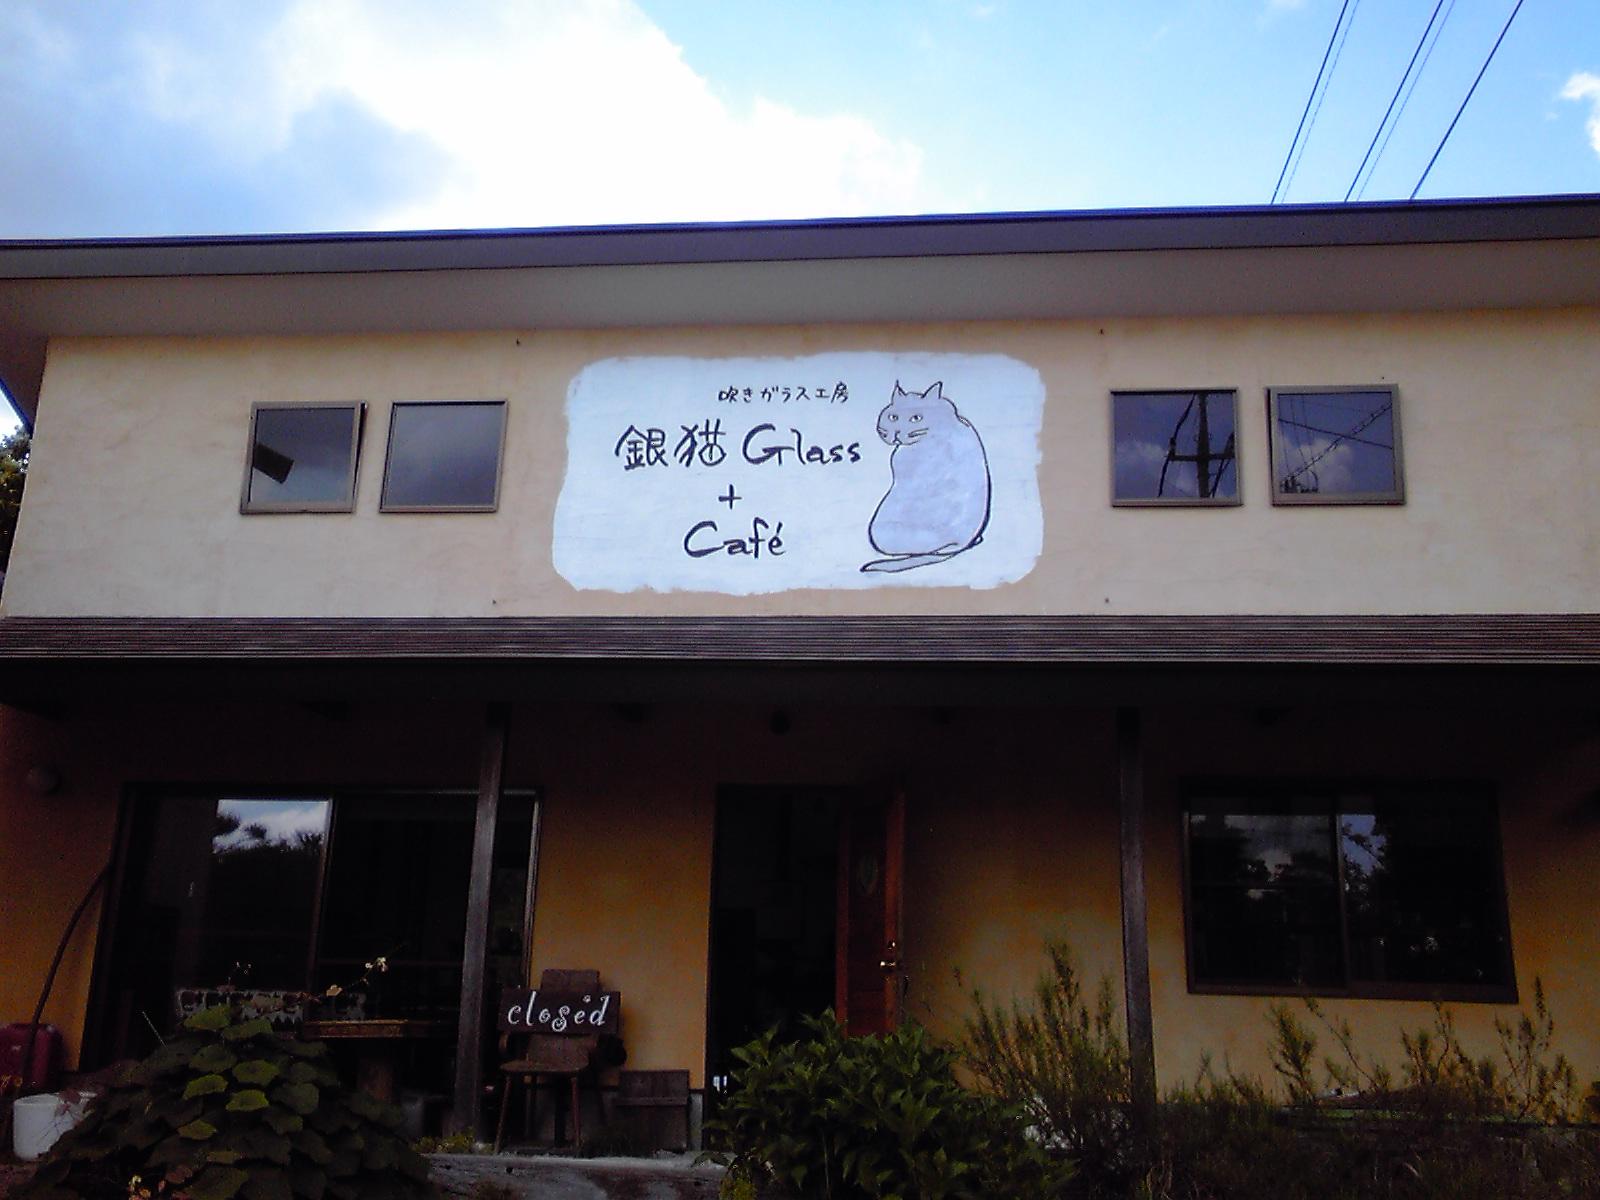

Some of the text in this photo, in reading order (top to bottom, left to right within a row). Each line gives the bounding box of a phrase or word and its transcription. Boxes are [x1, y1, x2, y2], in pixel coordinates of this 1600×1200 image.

[718, 381, 850, 404] 吹きガラス工房
[614, 418, 862, 471] 銀猫 Glass
[718, 483, 742, 510] +
[683, 517, 787, 559] Café
[507, 990, 611, 1032] closed
